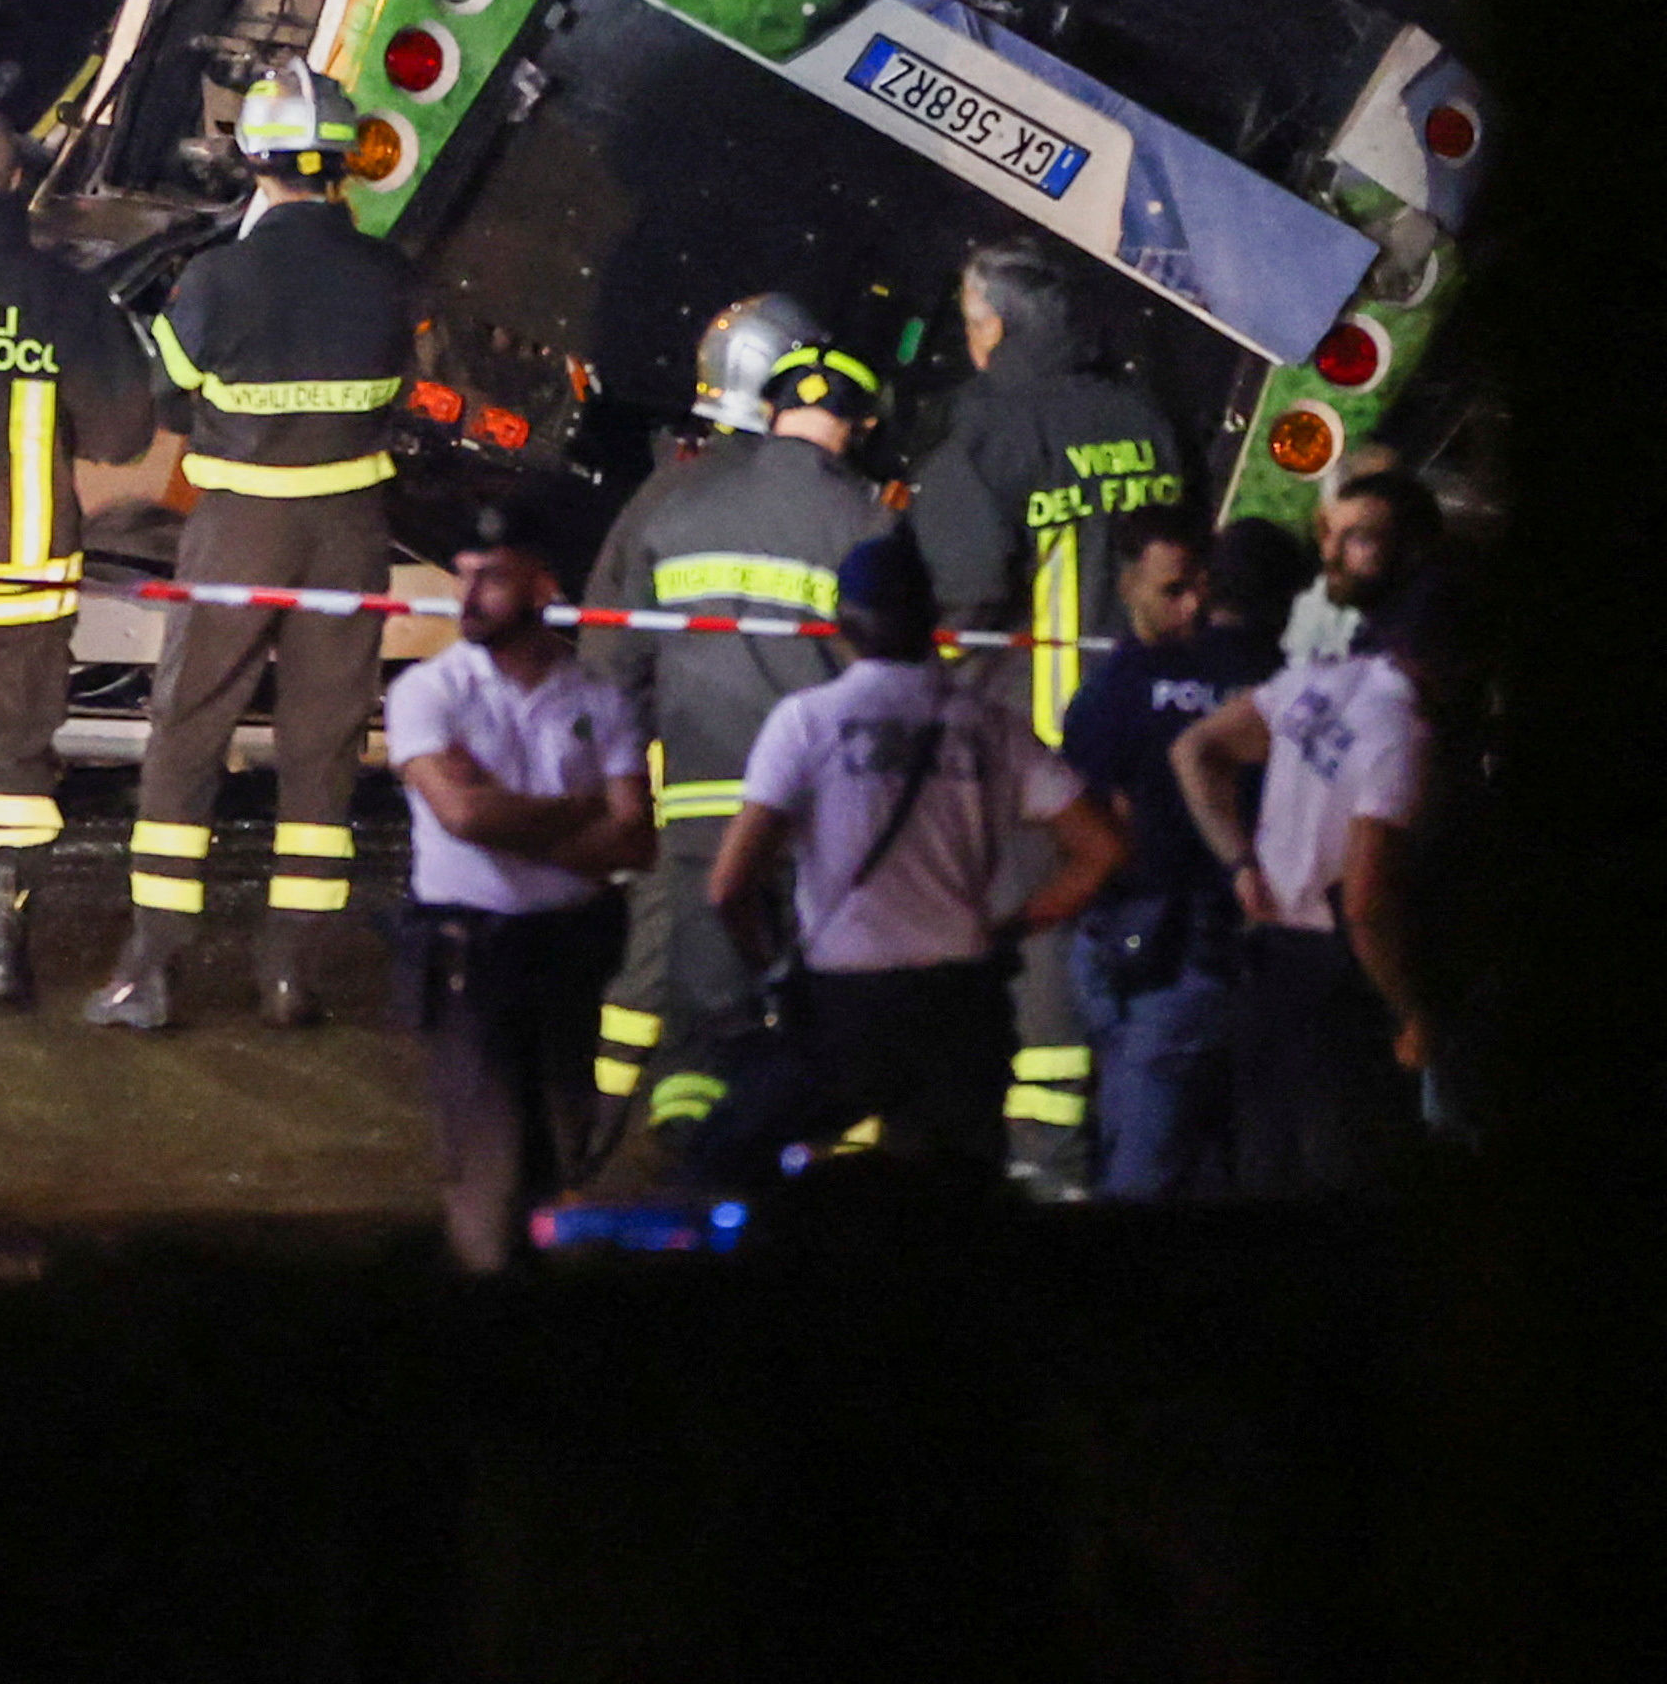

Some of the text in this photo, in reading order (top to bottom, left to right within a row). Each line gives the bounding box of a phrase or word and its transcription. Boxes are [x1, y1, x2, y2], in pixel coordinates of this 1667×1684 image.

[878, 56, 1055, 176] GK 568RZ
[295, 384, 335, 408] DEL
[1026, 484, 1094, 528] DEL
